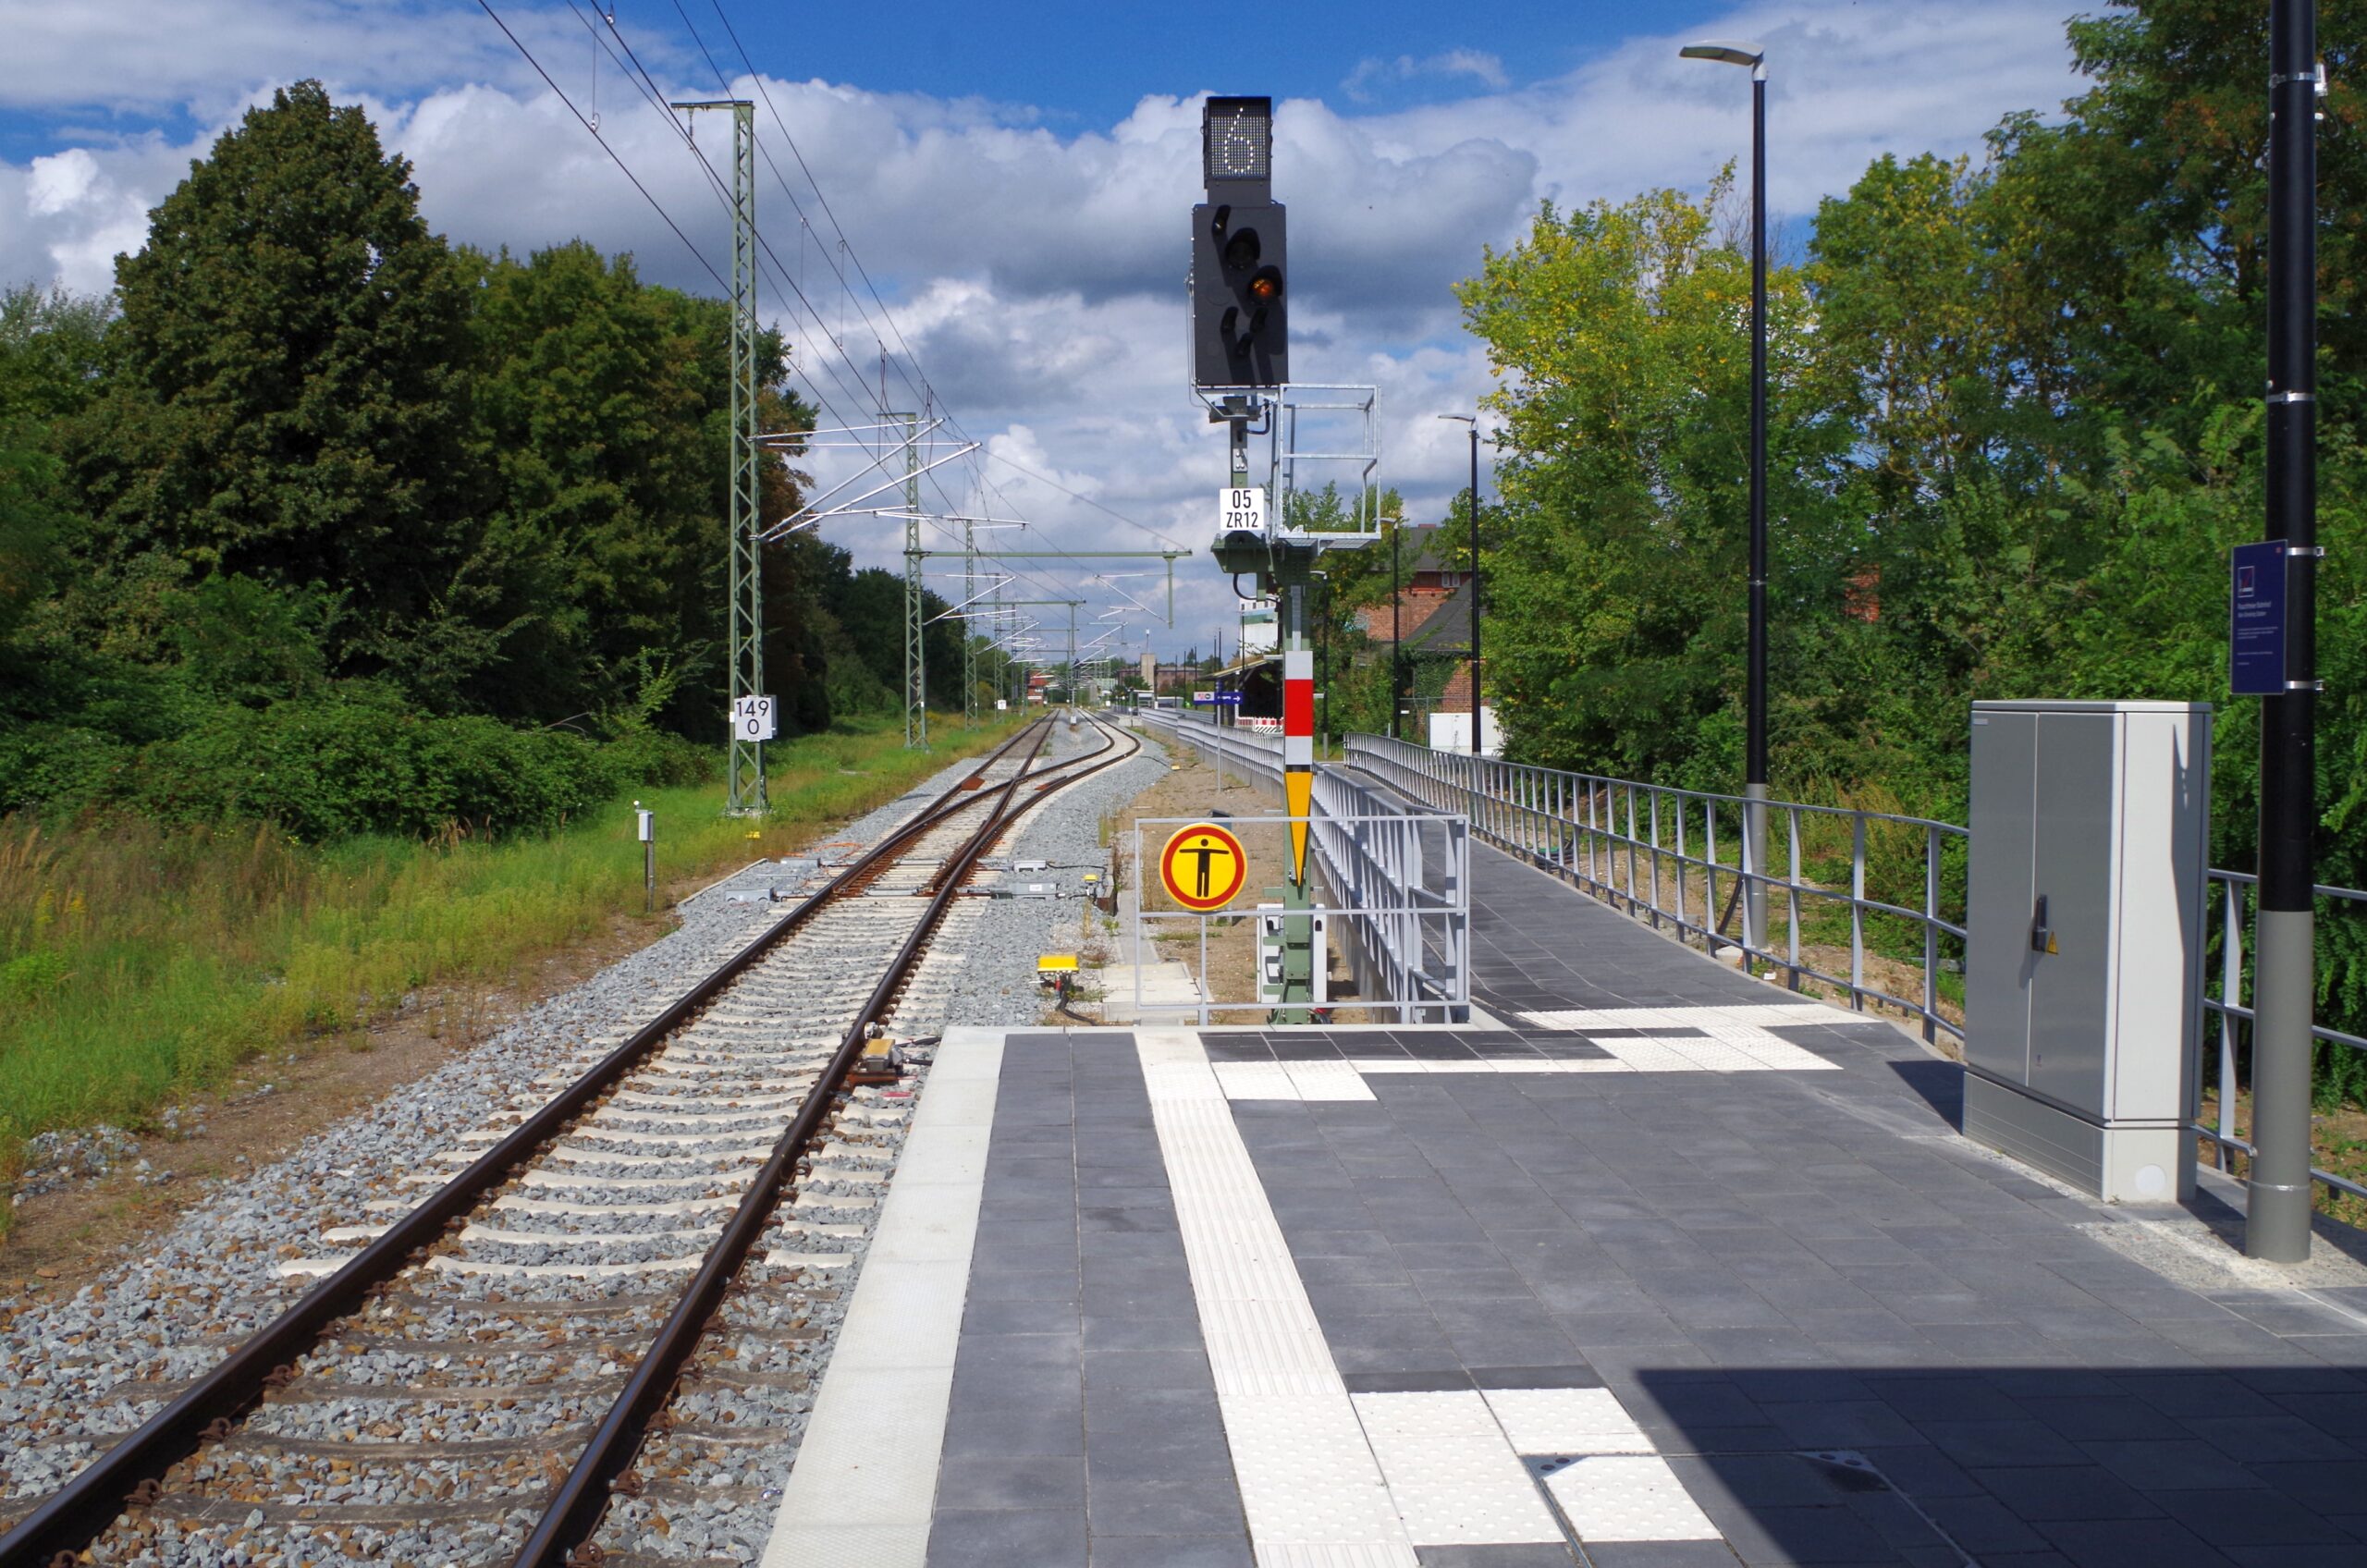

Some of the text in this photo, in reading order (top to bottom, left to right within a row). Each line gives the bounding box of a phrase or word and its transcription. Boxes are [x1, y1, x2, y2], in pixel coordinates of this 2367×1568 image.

[1223, 106, 1254, 173] 6
[1233, 490, 1251, 508] 05
[1226, 511, 1258, 528] ZR12
[736, 700, 769, 717] 149
[747, 718, 759, 735] 0
